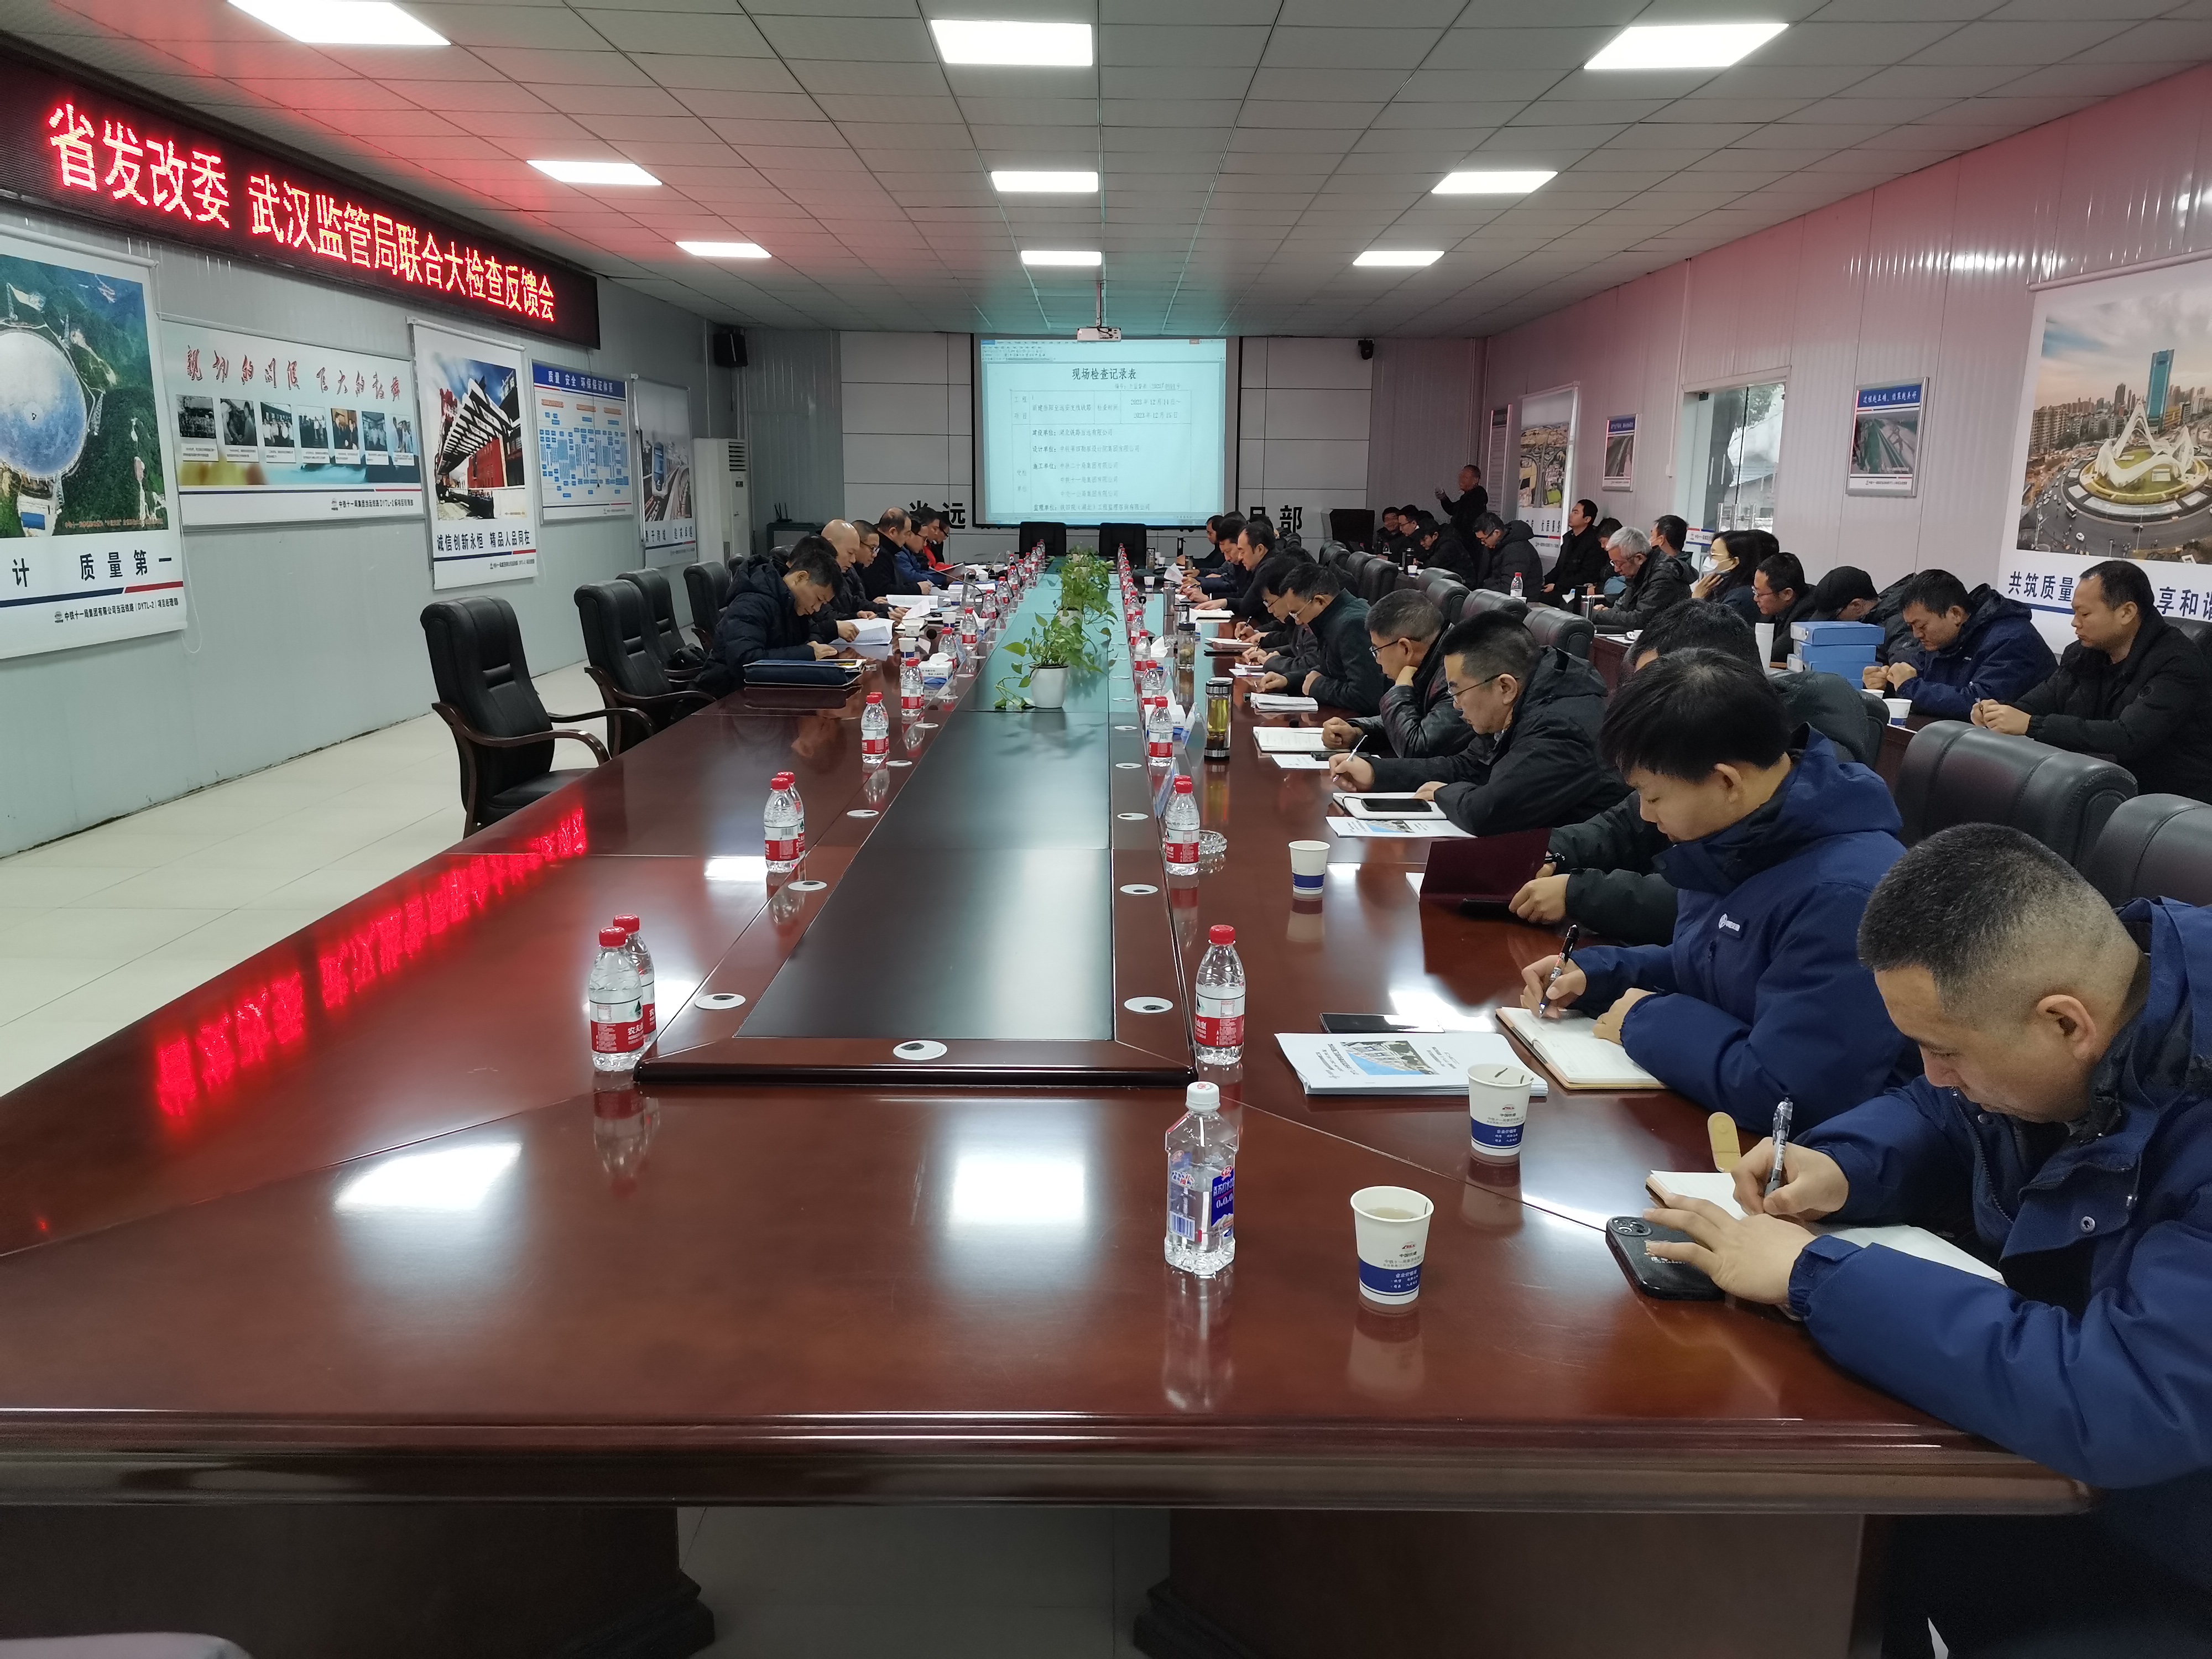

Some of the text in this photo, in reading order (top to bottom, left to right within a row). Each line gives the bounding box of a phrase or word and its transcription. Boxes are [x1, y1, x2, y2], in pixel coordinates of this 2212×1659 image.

[48, 103, 555, 321] 省发改委 武汉监管局联合大检查反馈会
[548, 370, 561, 384] 质量
[565, 373, 576, 387] 安全
[1072, 367, 1136, 380] 现场检查记录表
[437, 529, 530, 551] 诚信创新永恒 精品人品同在
[12, 549, 172, 587] 计 质量第一
[2007, 570, 2074, 602] 共筑质量
